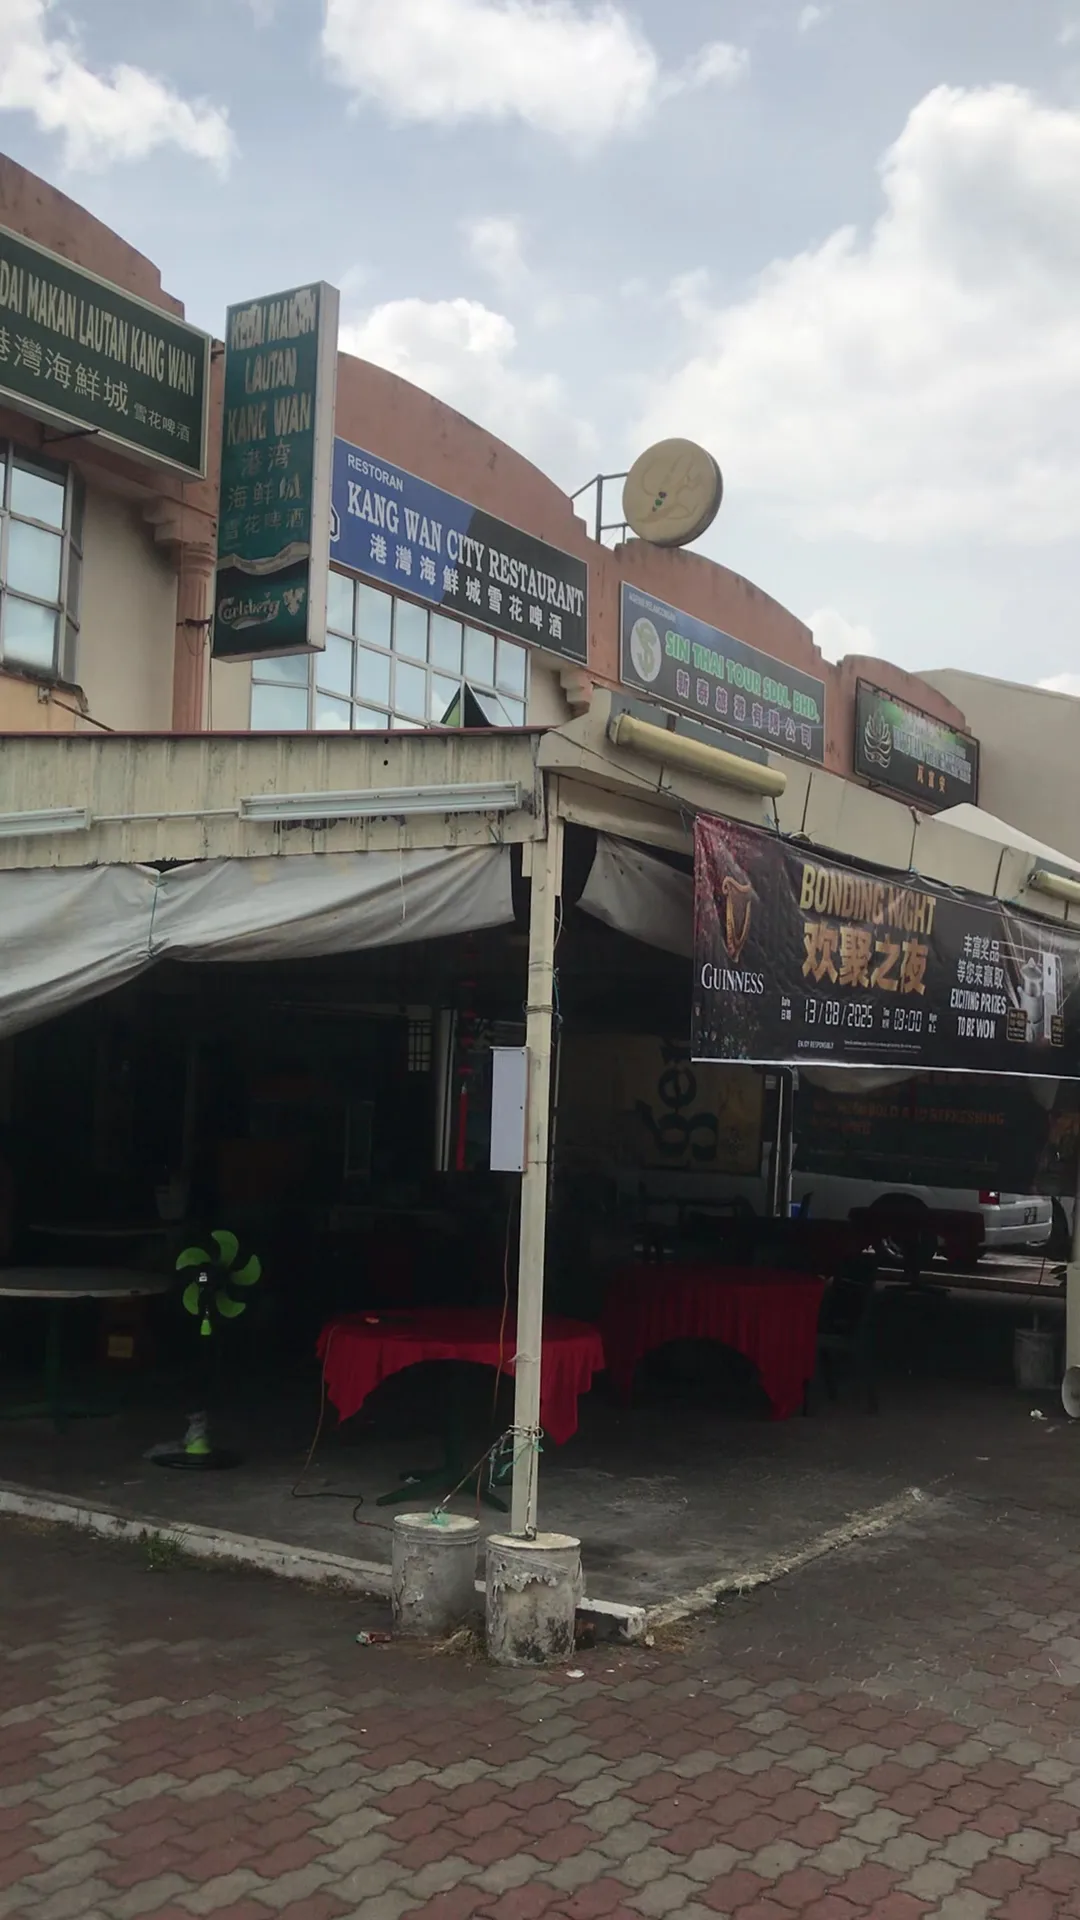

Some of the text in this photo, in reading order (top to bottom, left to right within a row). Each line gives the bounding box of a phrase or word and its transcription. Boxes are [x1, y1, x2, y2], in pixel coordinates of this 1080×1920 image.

[28, 273, 77, 338] MAKAN
[79, 300, 128, 361] LAUTAN
[130, 326, 165, 383] KANG
[167, 343, 196, 397] WAN
[245, 347, 298, 394] LAUTAN
[133, 402, 190, 443] 雪花啤酒
[227, 392, 311, 445] KANG WAN
[347, 453, 403, 492] RESTORAN
[347, 480, 585, 617] KANG WAN CITY RESTAURANT
[369, 533, 562, 640] 港灣海鮮城雪花啤酒
[665, 630, 690, 664] SIN
[692, 642, 724, 680] THAI
[726, 658, 761, 696] TOUR
[799, 863, 936, 935] BONDING NIGHT
[802, 920, 929, 995] 欢聚之夜
[963, 933, 1000, 963] 丰富奖品
[701, 963, 765, 994] GUINNESS
[804, 998, 873, 1028] 13/08/2025
[894, 1008, 922, 1032] 03:00
[950, 988, 1007, 1016] EXCITING PRIZES
[958, 1016, 966, 1036] TO
[966, 1017, 976, 1037] BE
[976, 1018, 996, 1039] WON
